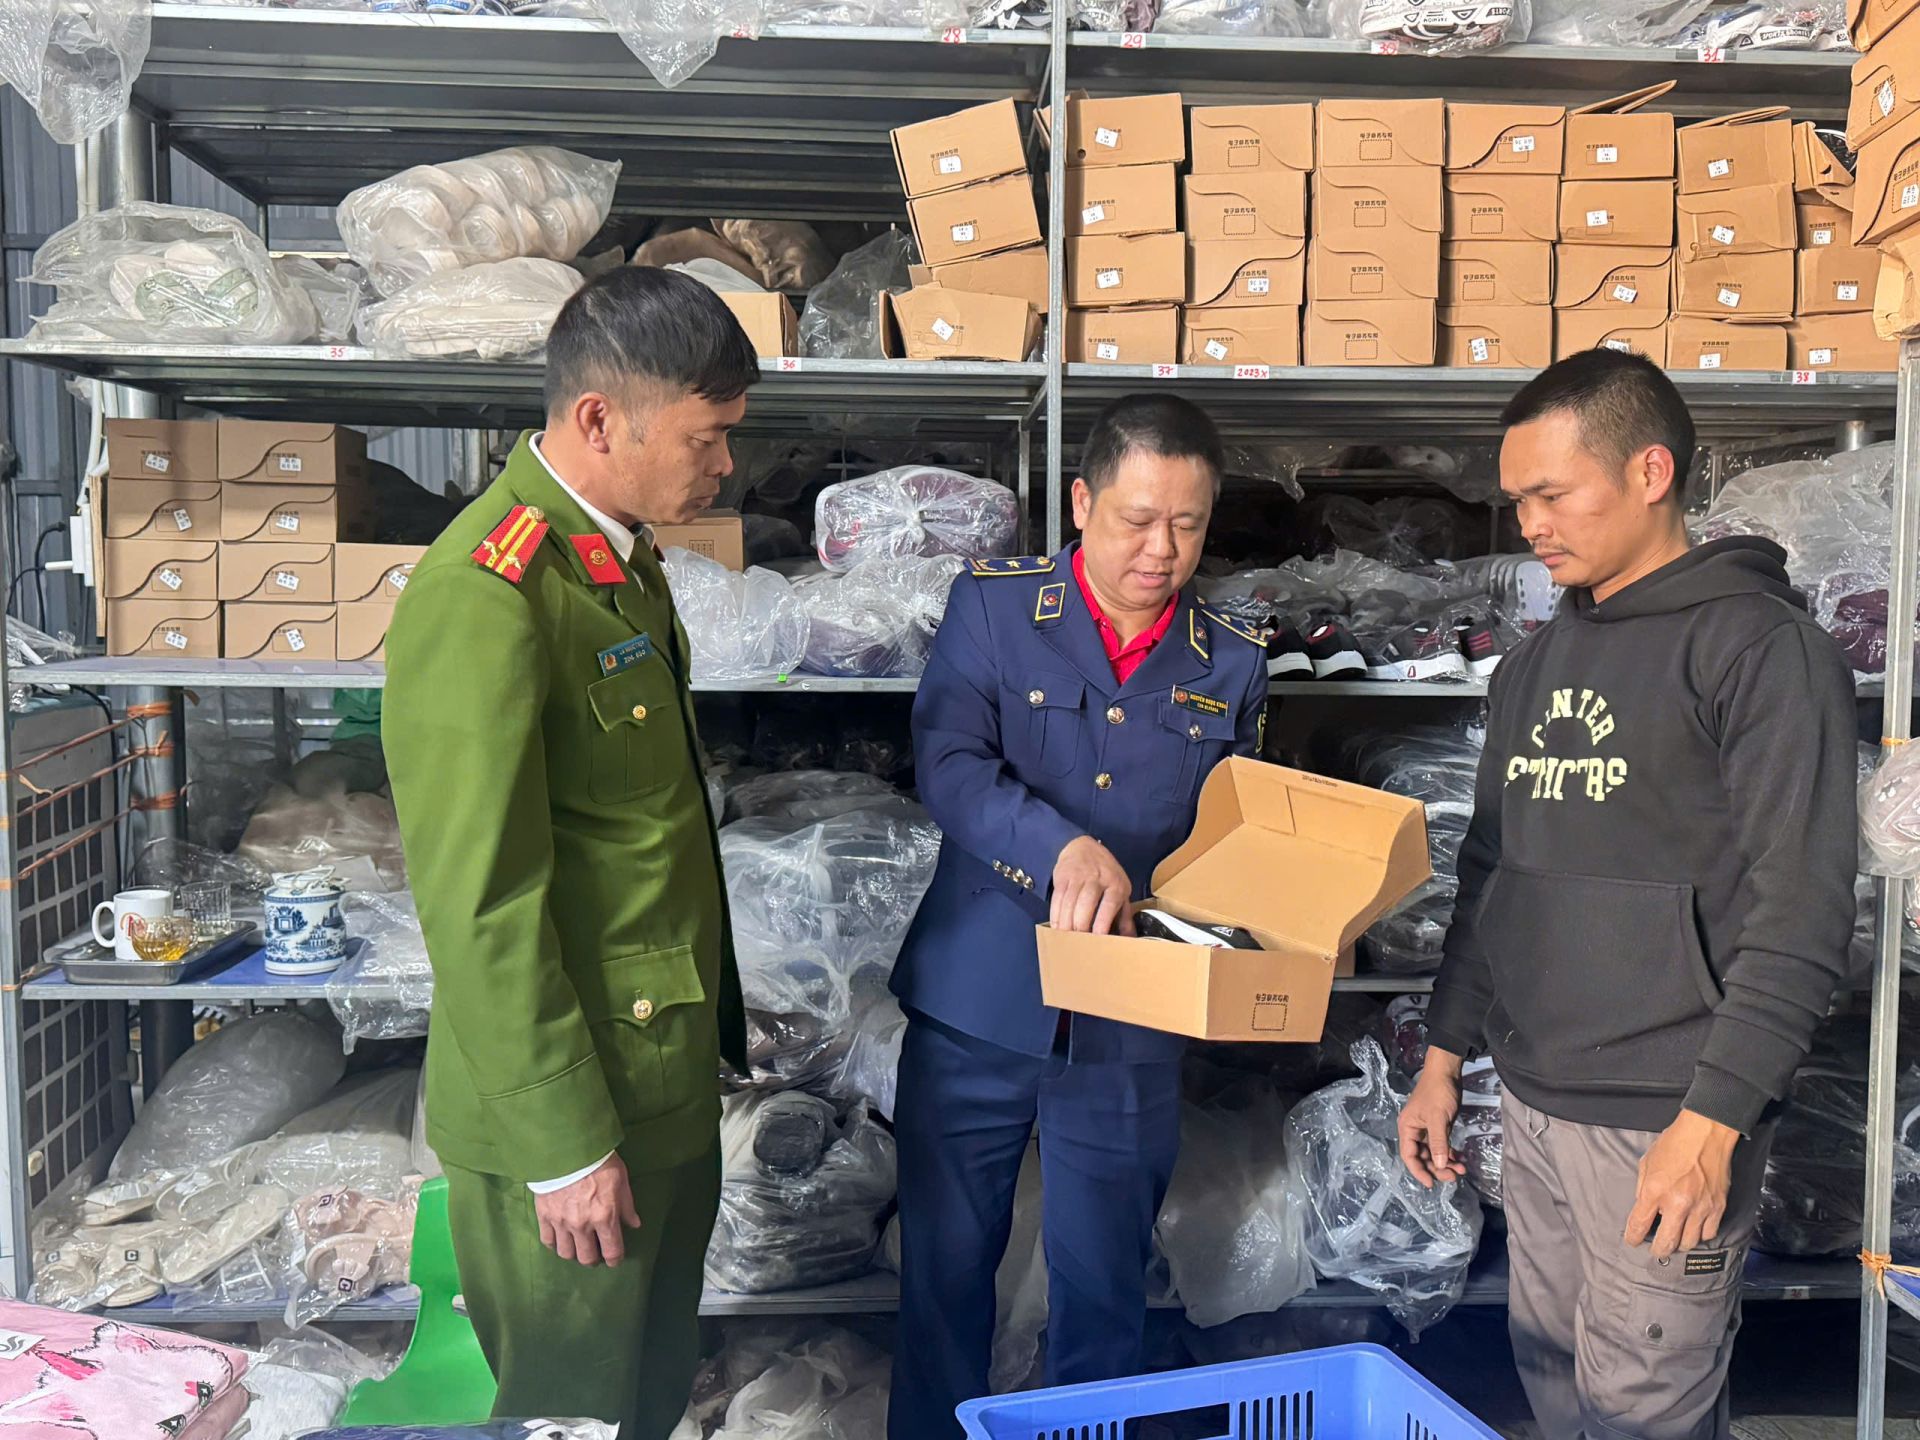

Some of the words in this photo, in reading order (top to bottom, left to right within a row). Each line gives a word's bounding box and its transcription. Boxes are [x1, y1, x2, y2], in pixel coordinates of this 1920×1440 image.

[943, 27, 961, 44] 28
[1124, 34, 1143, 48] 29
[1379, 41, 1398, 55] 30
[1704, 48, 1721, 63] 31
[330, 348, 346, 358] 35
[783, 360, 796, 370] 36
[1157, 365, 1173, 377] 37
[1796, 371, 1810, 383] 38
